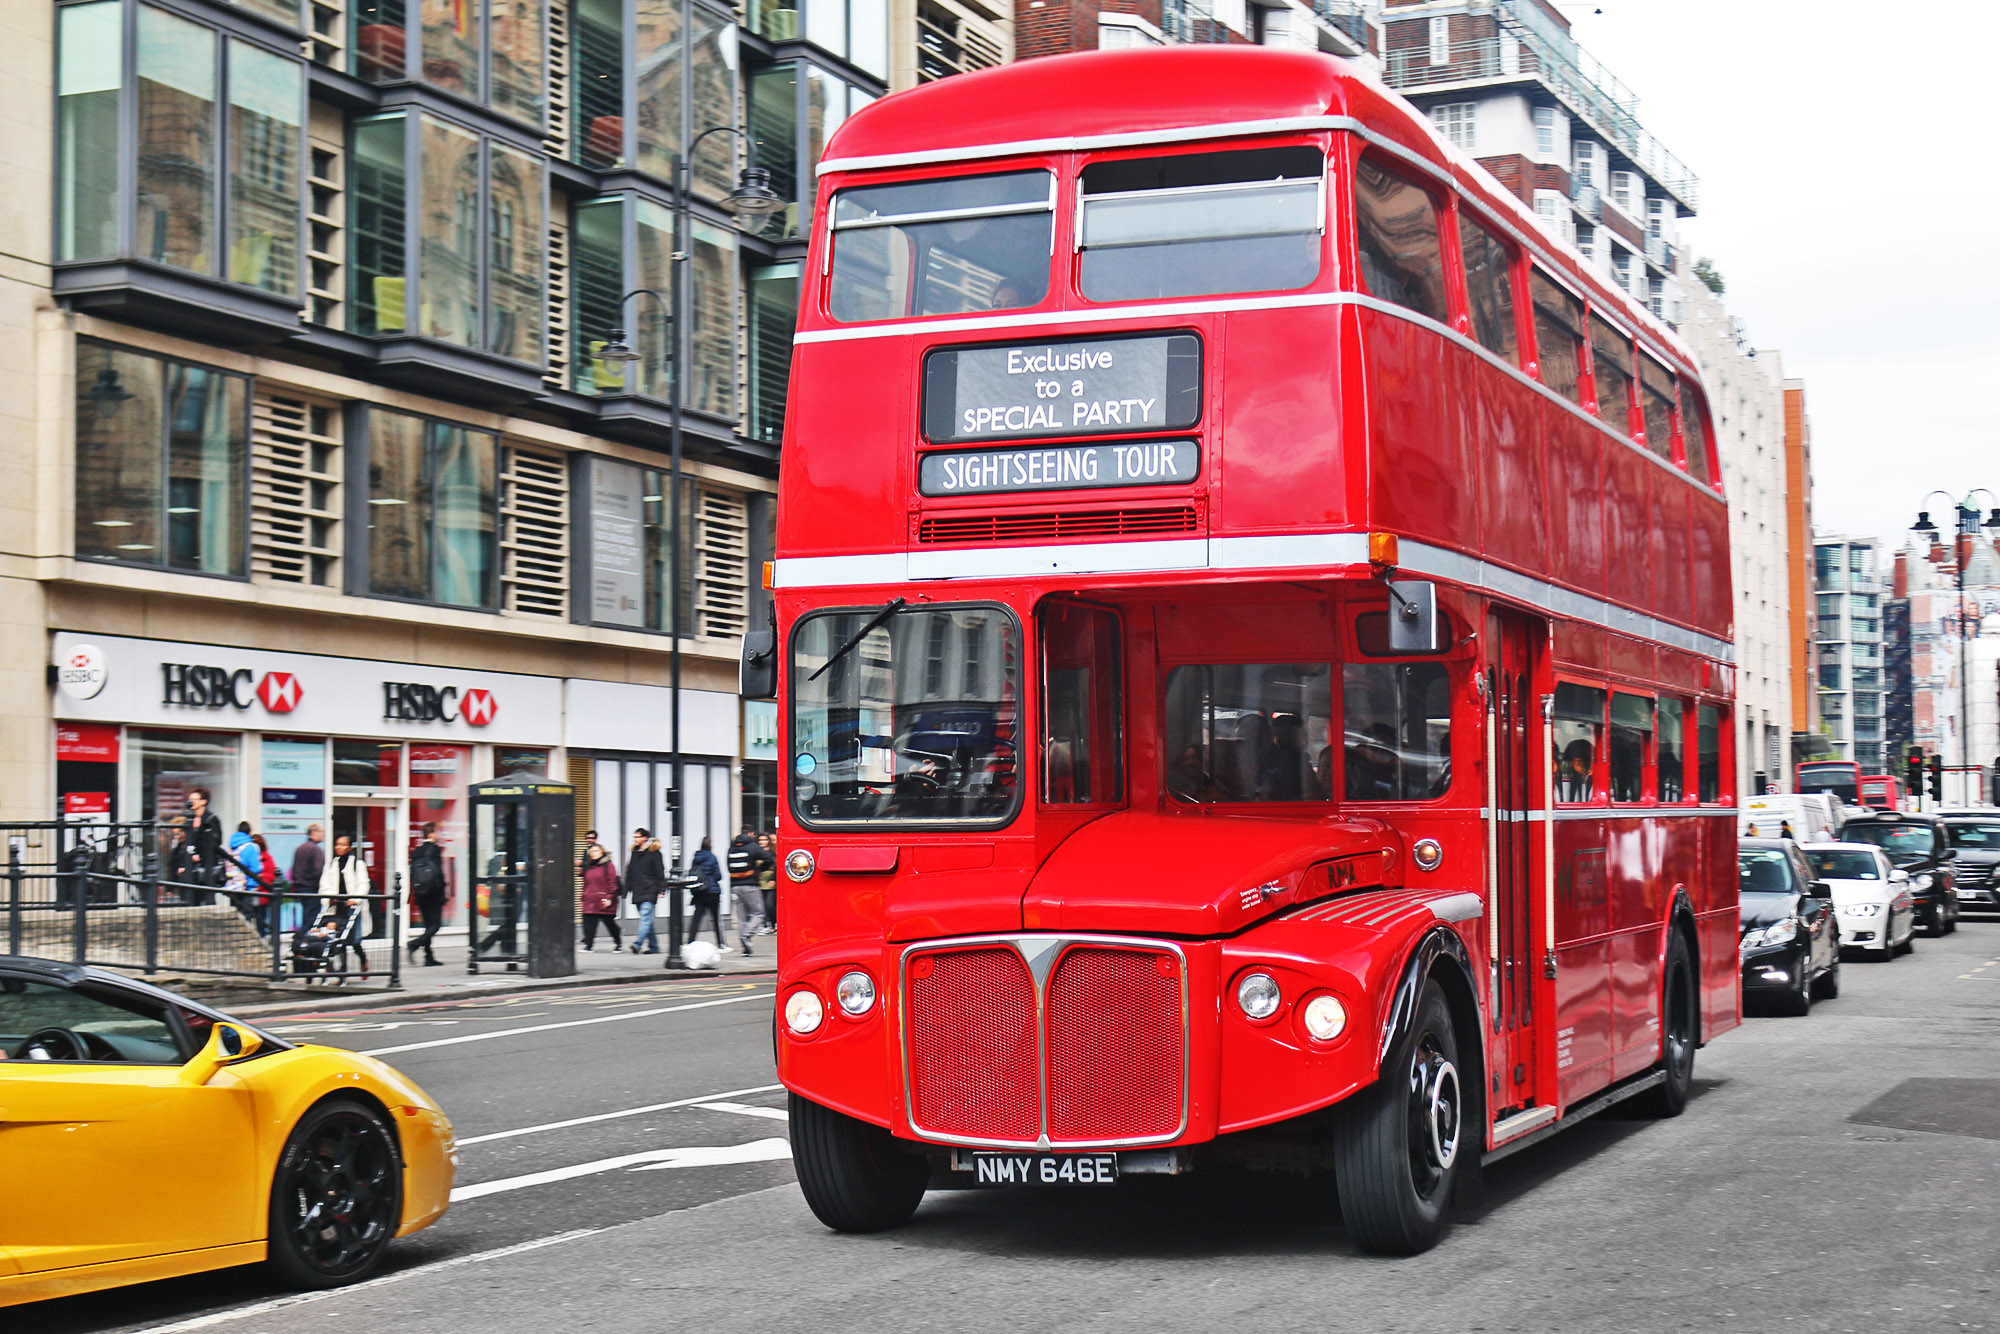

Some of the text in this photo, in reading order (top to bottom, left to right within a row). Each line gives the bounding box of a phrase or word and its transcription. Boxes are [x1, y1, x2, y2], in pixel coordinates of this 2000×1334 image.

[1007, 348, 1113, 374] Exclusive
[1034, 378, 1084, 398] to a
[962, 398, 1156, 433] SPECIAL PARTY
[942, 444, 1178, 490] SIGHTSEEING TOUR
[62, 669, 101, 684] HSBC
[161, 662, 254, 710] HSBC
[382, 681, 458, 723] HSBC
[977, 1157, 1114, 1183] NMY 646E
